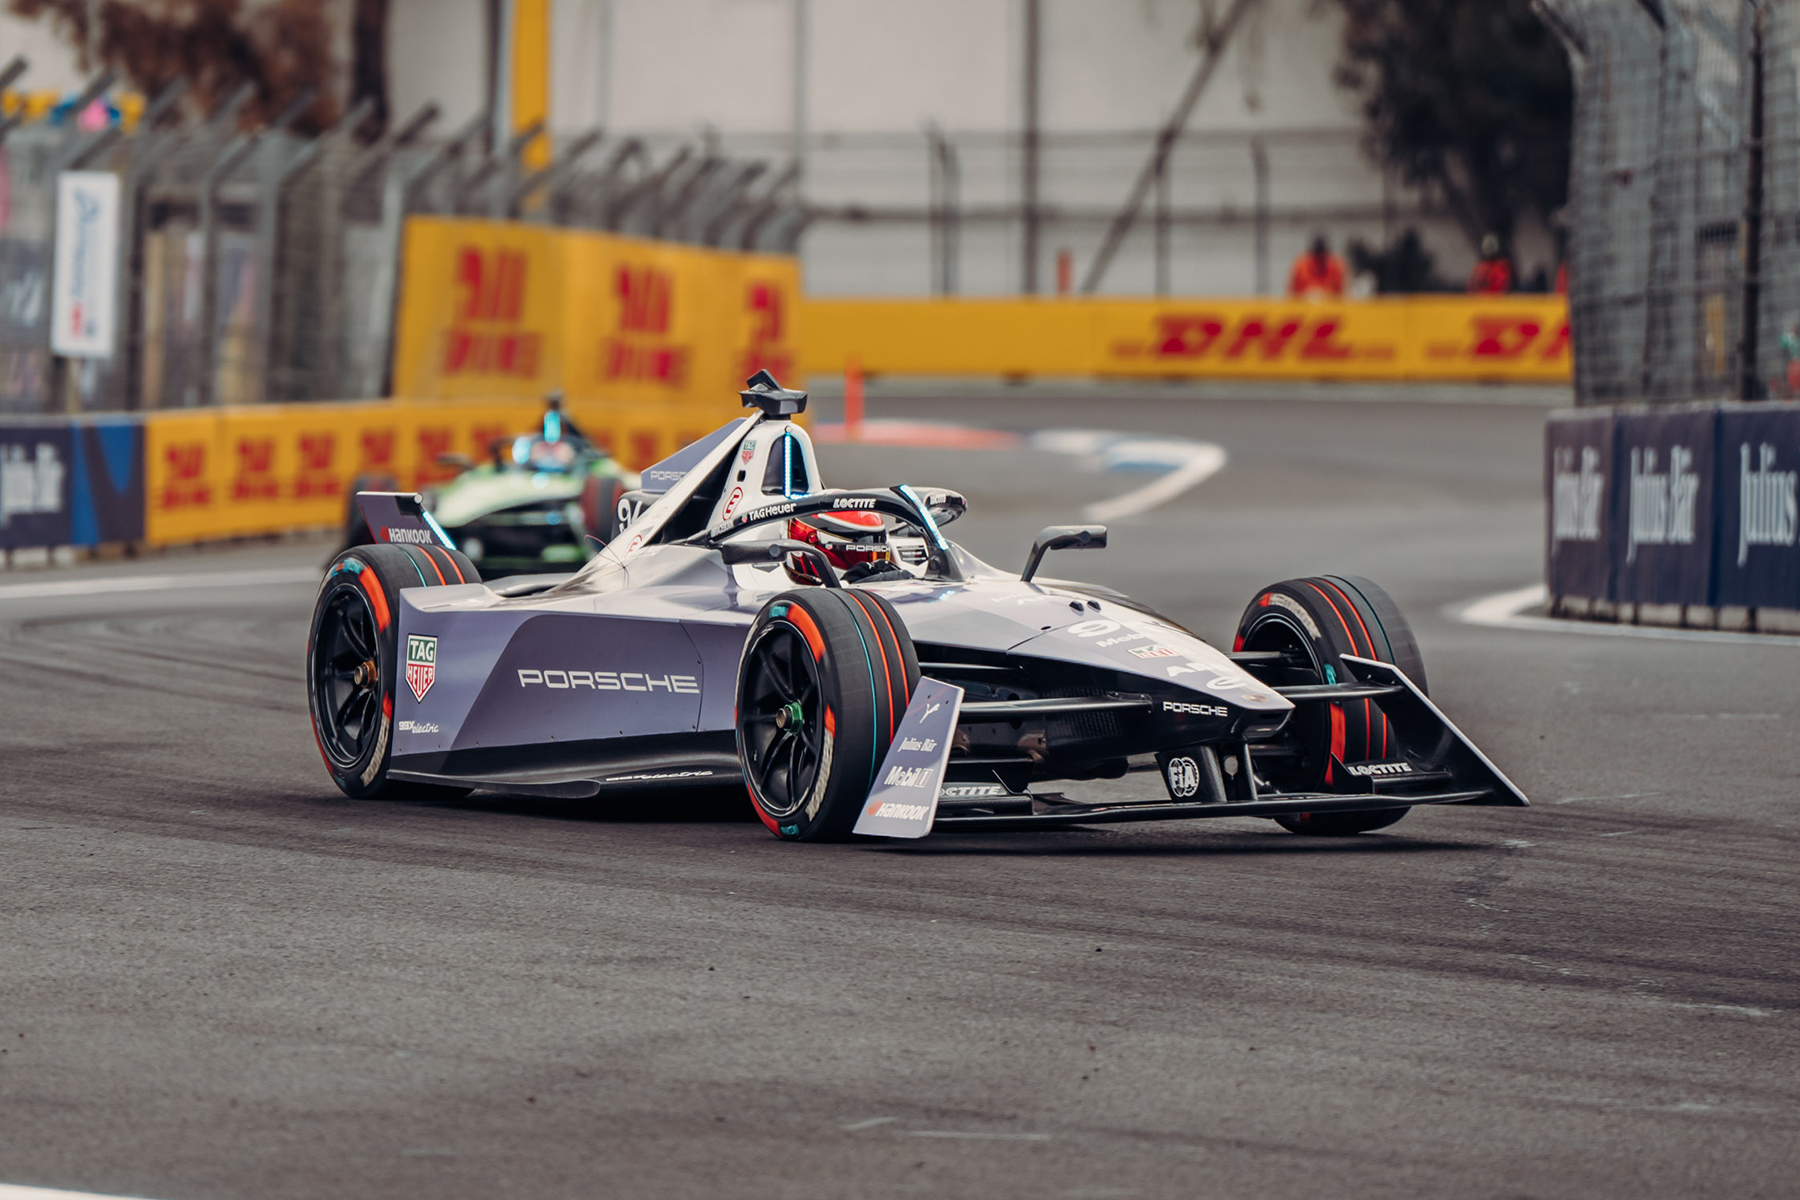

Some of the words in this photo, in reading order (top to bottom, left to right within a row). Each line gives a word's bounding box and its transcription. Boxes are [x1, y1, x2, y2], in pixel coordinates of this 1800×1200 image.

[1152, 315, 1352, 362] DHL
[833, 498, 877, 509] LOCTITE
[1737, 443, 1798, 568] Julius
[845, 543, 890, 552] PORSC
[410, 640, 434, 660] TAG
[406, 665, 434, 698] HEUER
[517, 669, 700, 694] PORSCHE
[1163, 701, 1228, 717] PORSCHE
[884, 765, 922, 787] Mobil
[1347, 762, 1412, 776] LOCTITE
